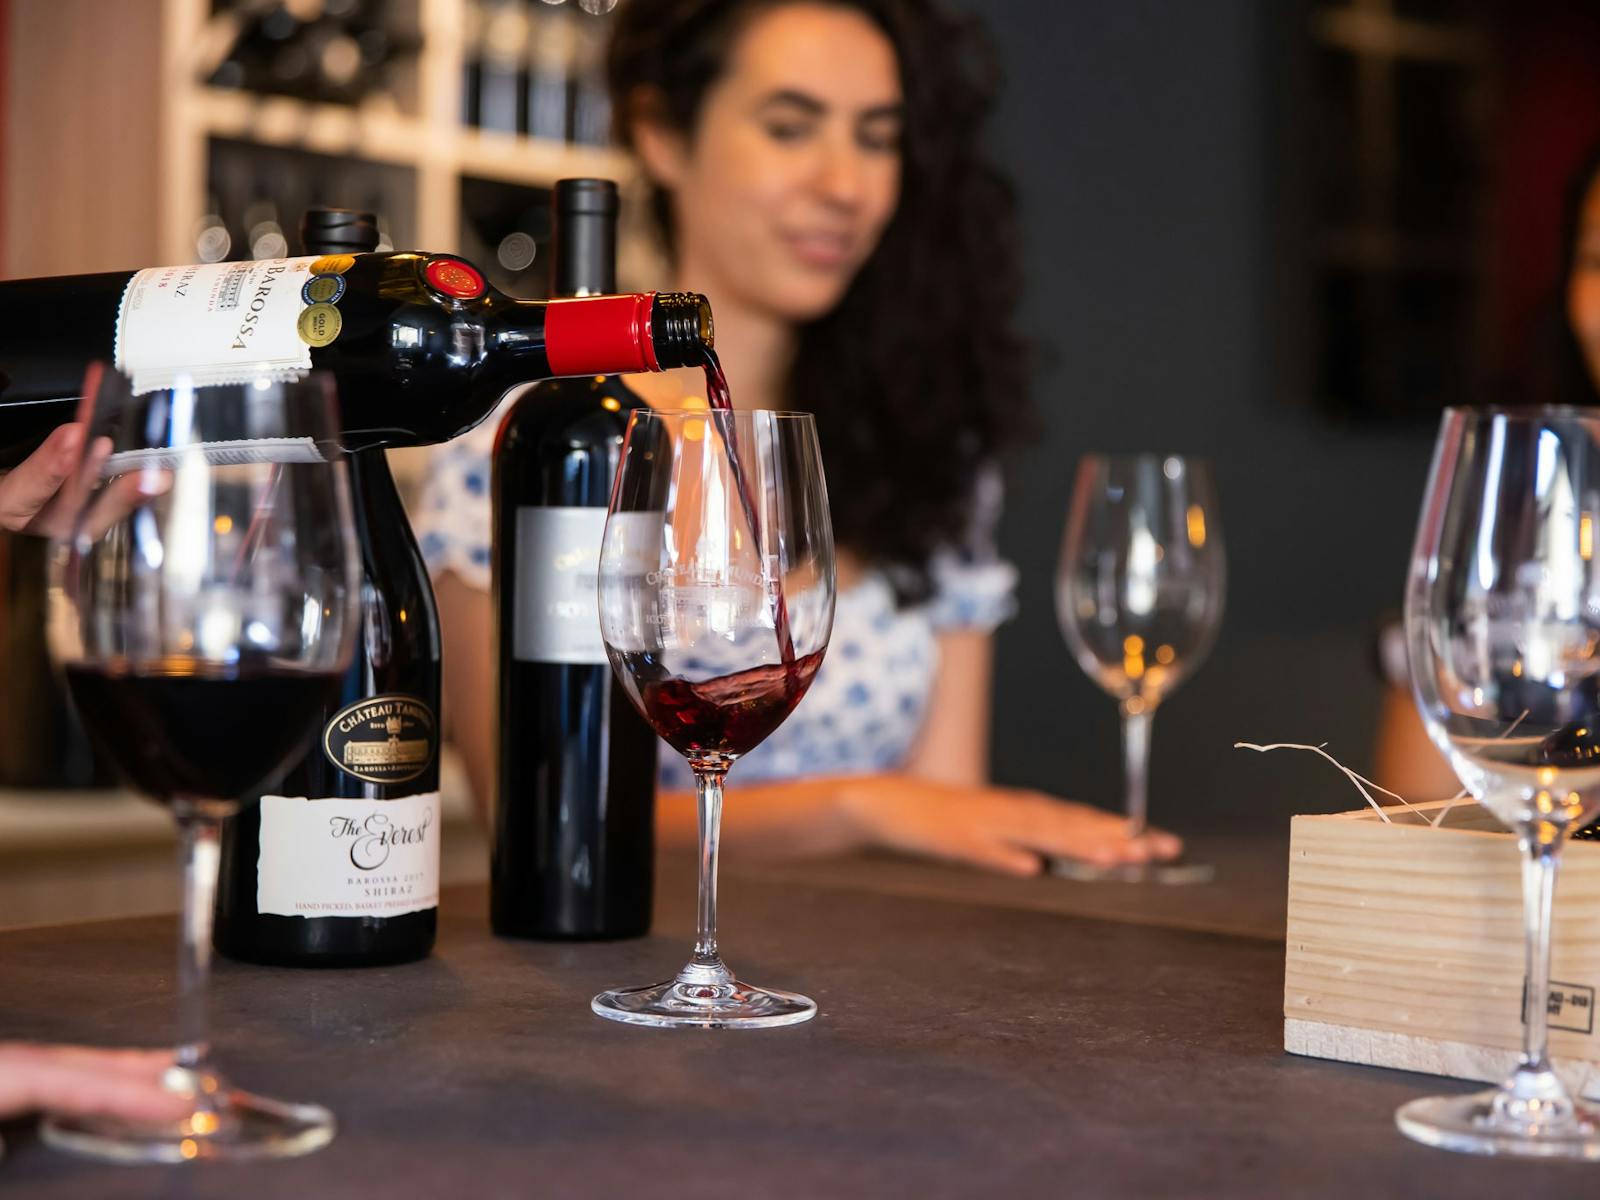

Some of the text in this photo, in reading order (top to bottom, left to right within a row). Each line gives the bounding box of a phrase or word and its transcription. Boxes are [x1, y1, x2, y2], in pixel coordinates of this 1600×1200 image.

[232, 266, 286, 349] BAROSSA
[338, 704, 393, 734] CHÂTEAU
[330, 806, 433, 871] The Everest
[347, 876, 398, 886] BAROSSA
[363, 885, 413, 897] SHIRAZ
[296, 902, 320, 911] HAND
